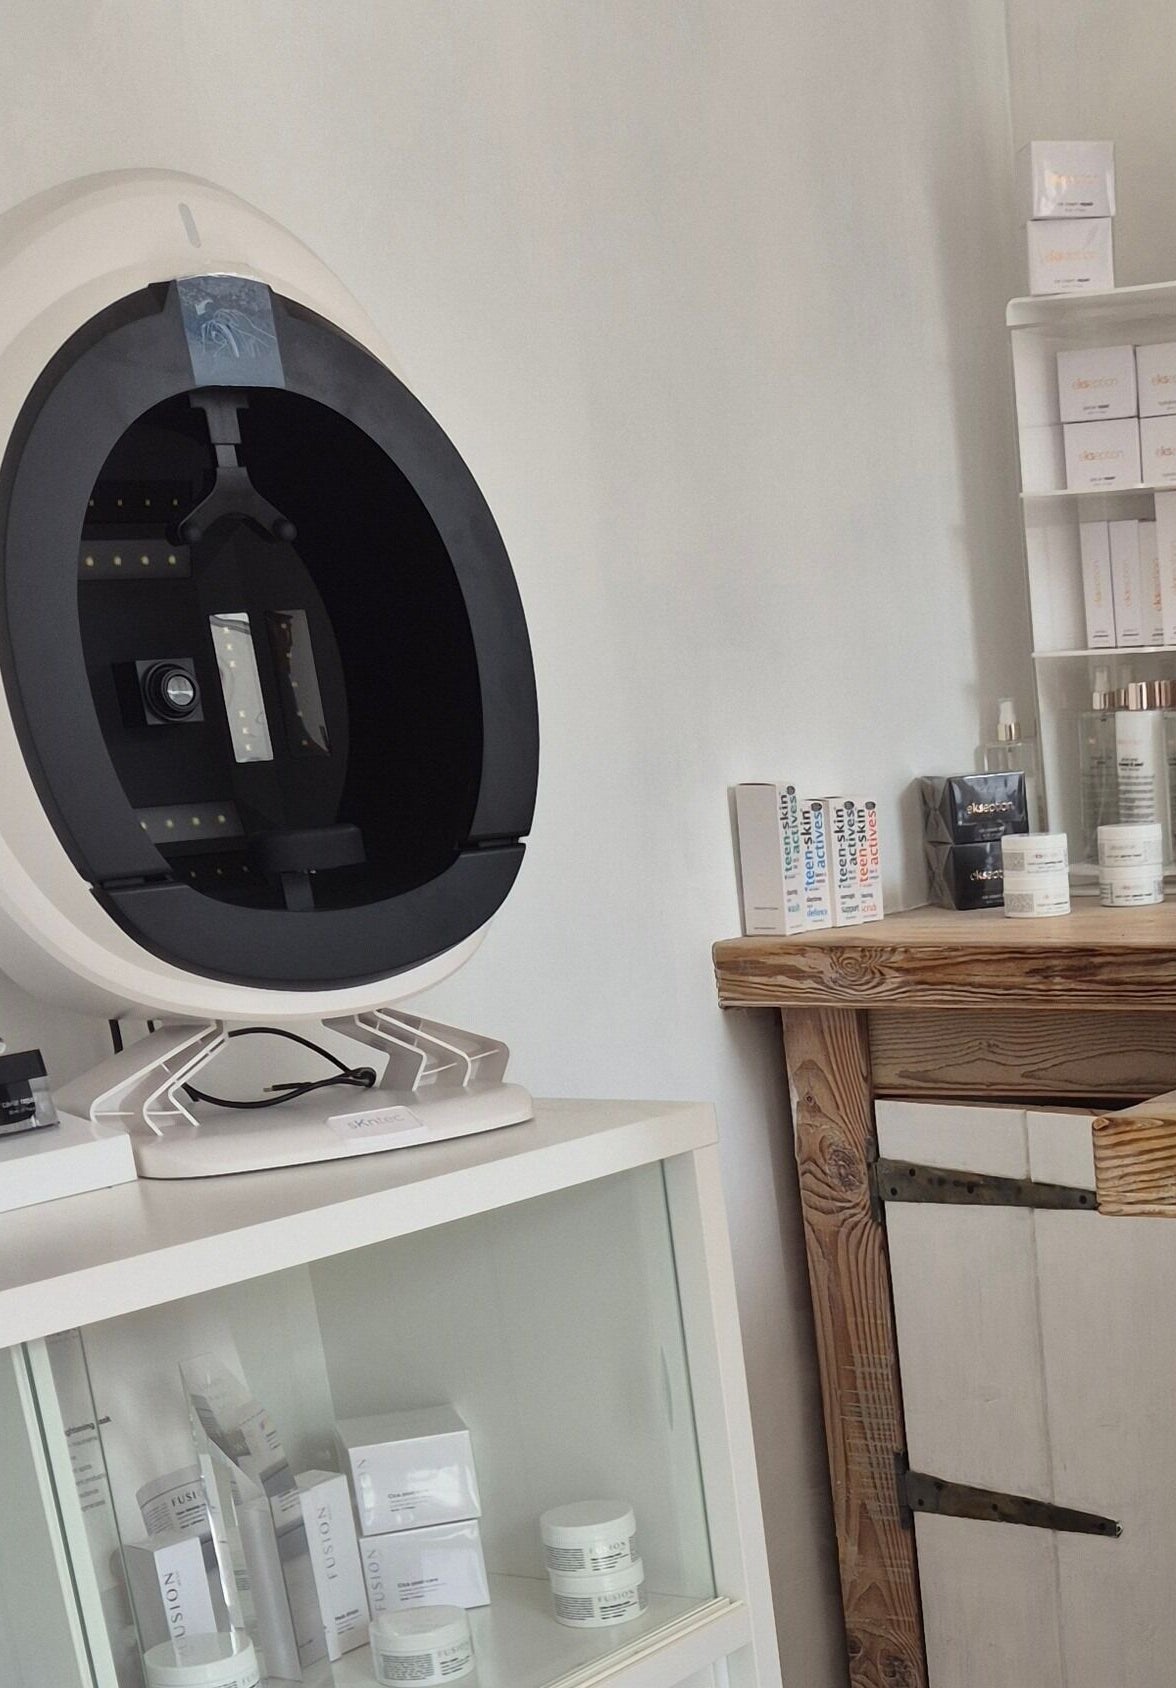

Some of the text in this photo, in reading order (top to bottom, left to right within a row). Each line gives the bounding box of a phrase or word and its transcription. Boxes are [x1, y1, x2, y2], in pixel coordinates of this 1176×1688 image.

[779, 794, 793, 872] teen-skin
[789, 795, 801, 854] actives
[800, 810, 815, 887] teen-skin
[813, 811, 826, 869] actives
[833, 808, 849, 884] teen-skin
[846, 809, 858, 866] actives
[856, 809, 869, 884] teen-skin
[867, 810, 880, 866] actives
[317, 1506, 338, 1581] FUSION
[367, 1549, 387, 1612] FUSION
